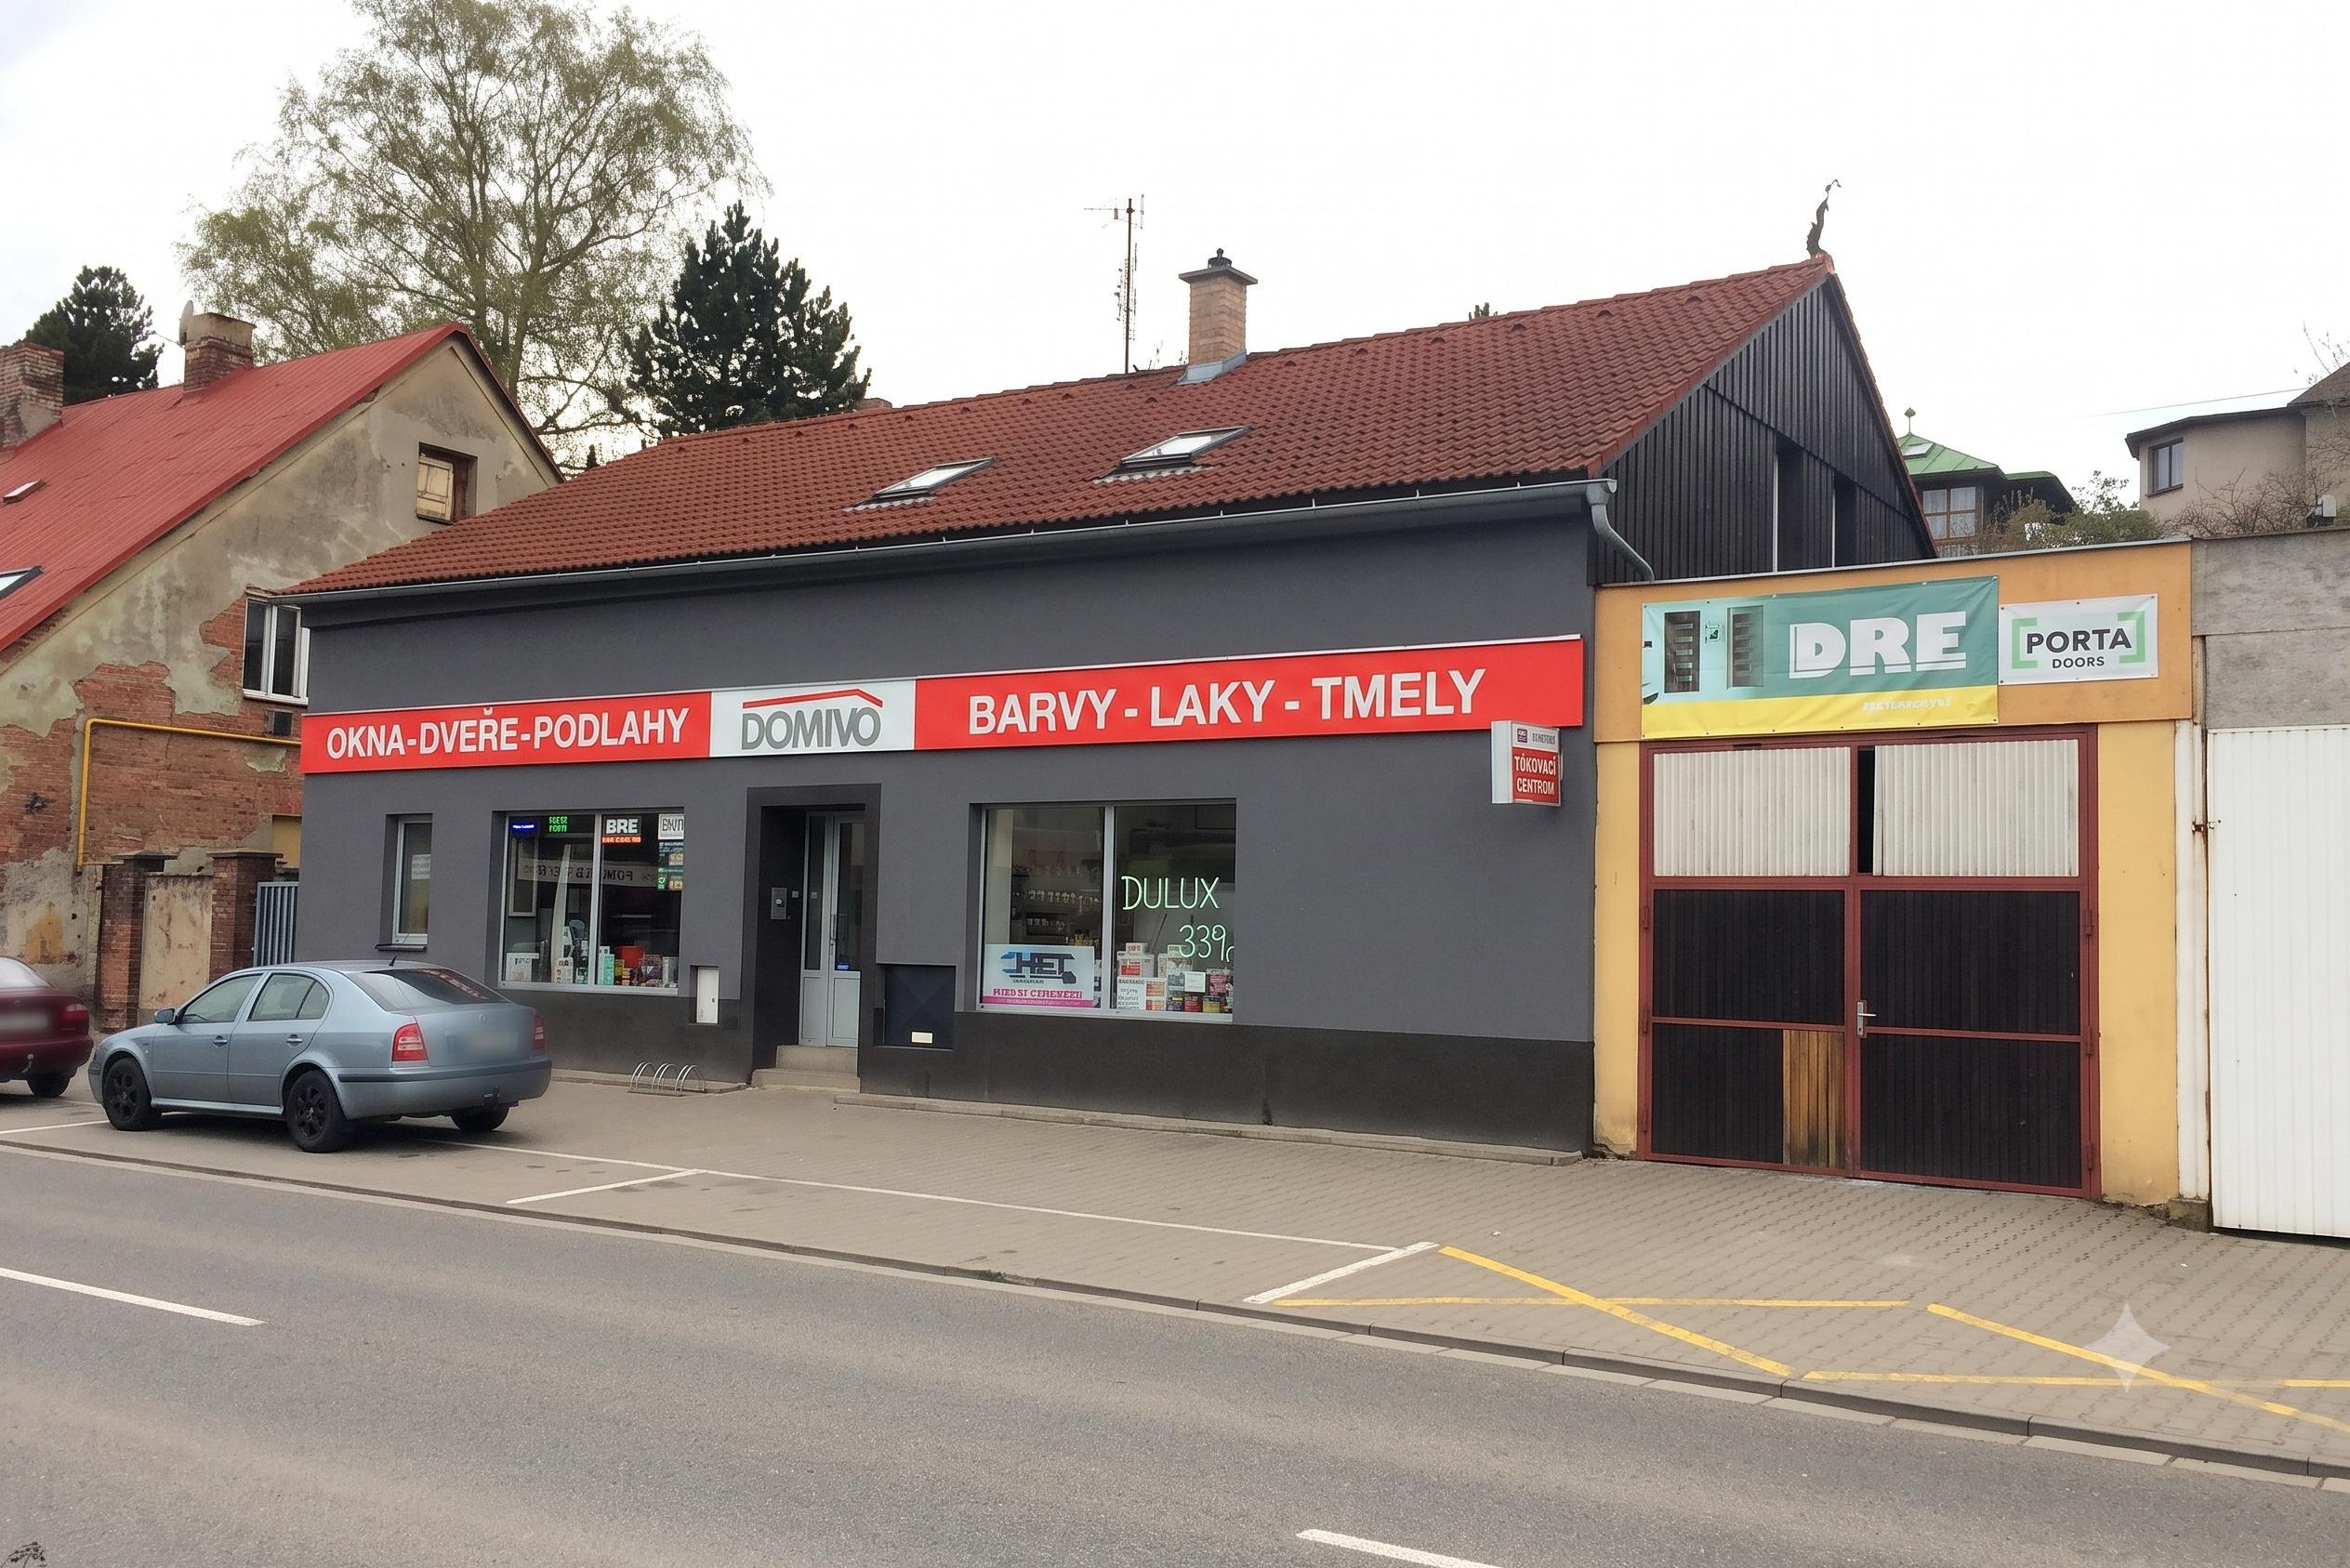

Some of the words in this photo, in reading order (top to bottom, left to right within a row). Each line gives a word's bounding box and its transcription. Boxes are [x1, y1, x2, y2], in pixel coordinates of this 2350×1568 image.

[1789, 611, 1967, 679] DRE
[2027, 627, 2132, 654] PORTA
[2052, 656, 2106, 669] DOORS
[969, 688, 1117, 735] BARVY
[1150, 679, 1276, 728] LAKY
[1311, 668, 1486, 720] TMELY
[741, 706, 881, 750] DOMIVO
[606, 818, 639, 835] BRE
[1121, 876, 1221, 911] DULUX
